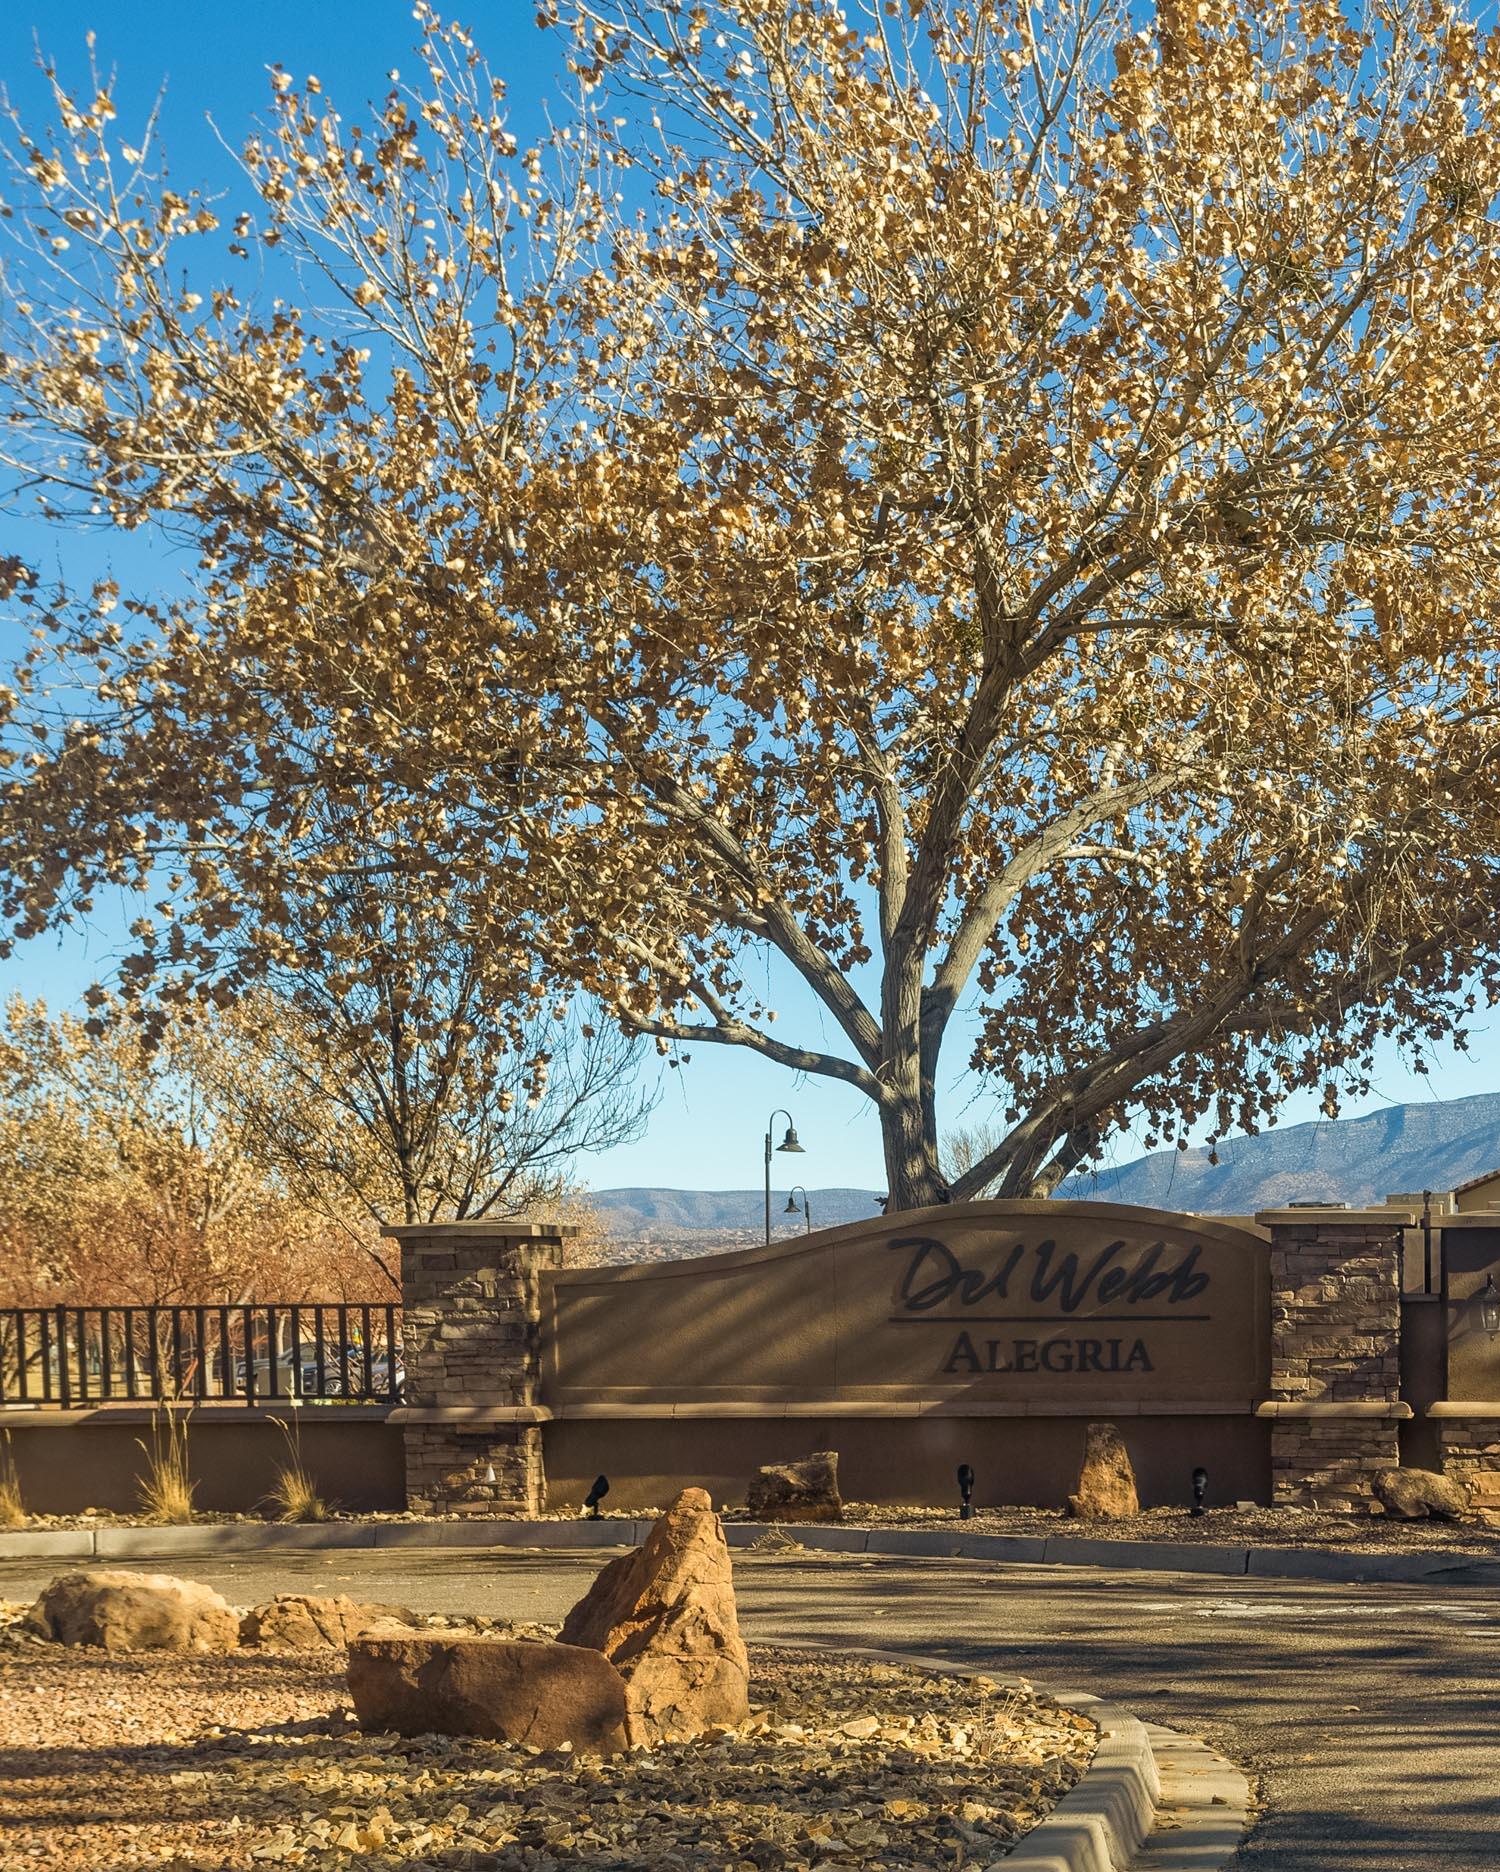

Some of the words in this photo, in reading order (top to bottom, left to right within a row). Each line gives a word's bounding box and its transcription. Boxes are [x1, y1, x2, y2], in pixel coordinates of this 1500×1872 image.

[888, 1236, 1025, 1311] Del
[1029, 1239, 1210, 1313] Webb
[941, 1331, 1155, 1374] ALEGRIA
